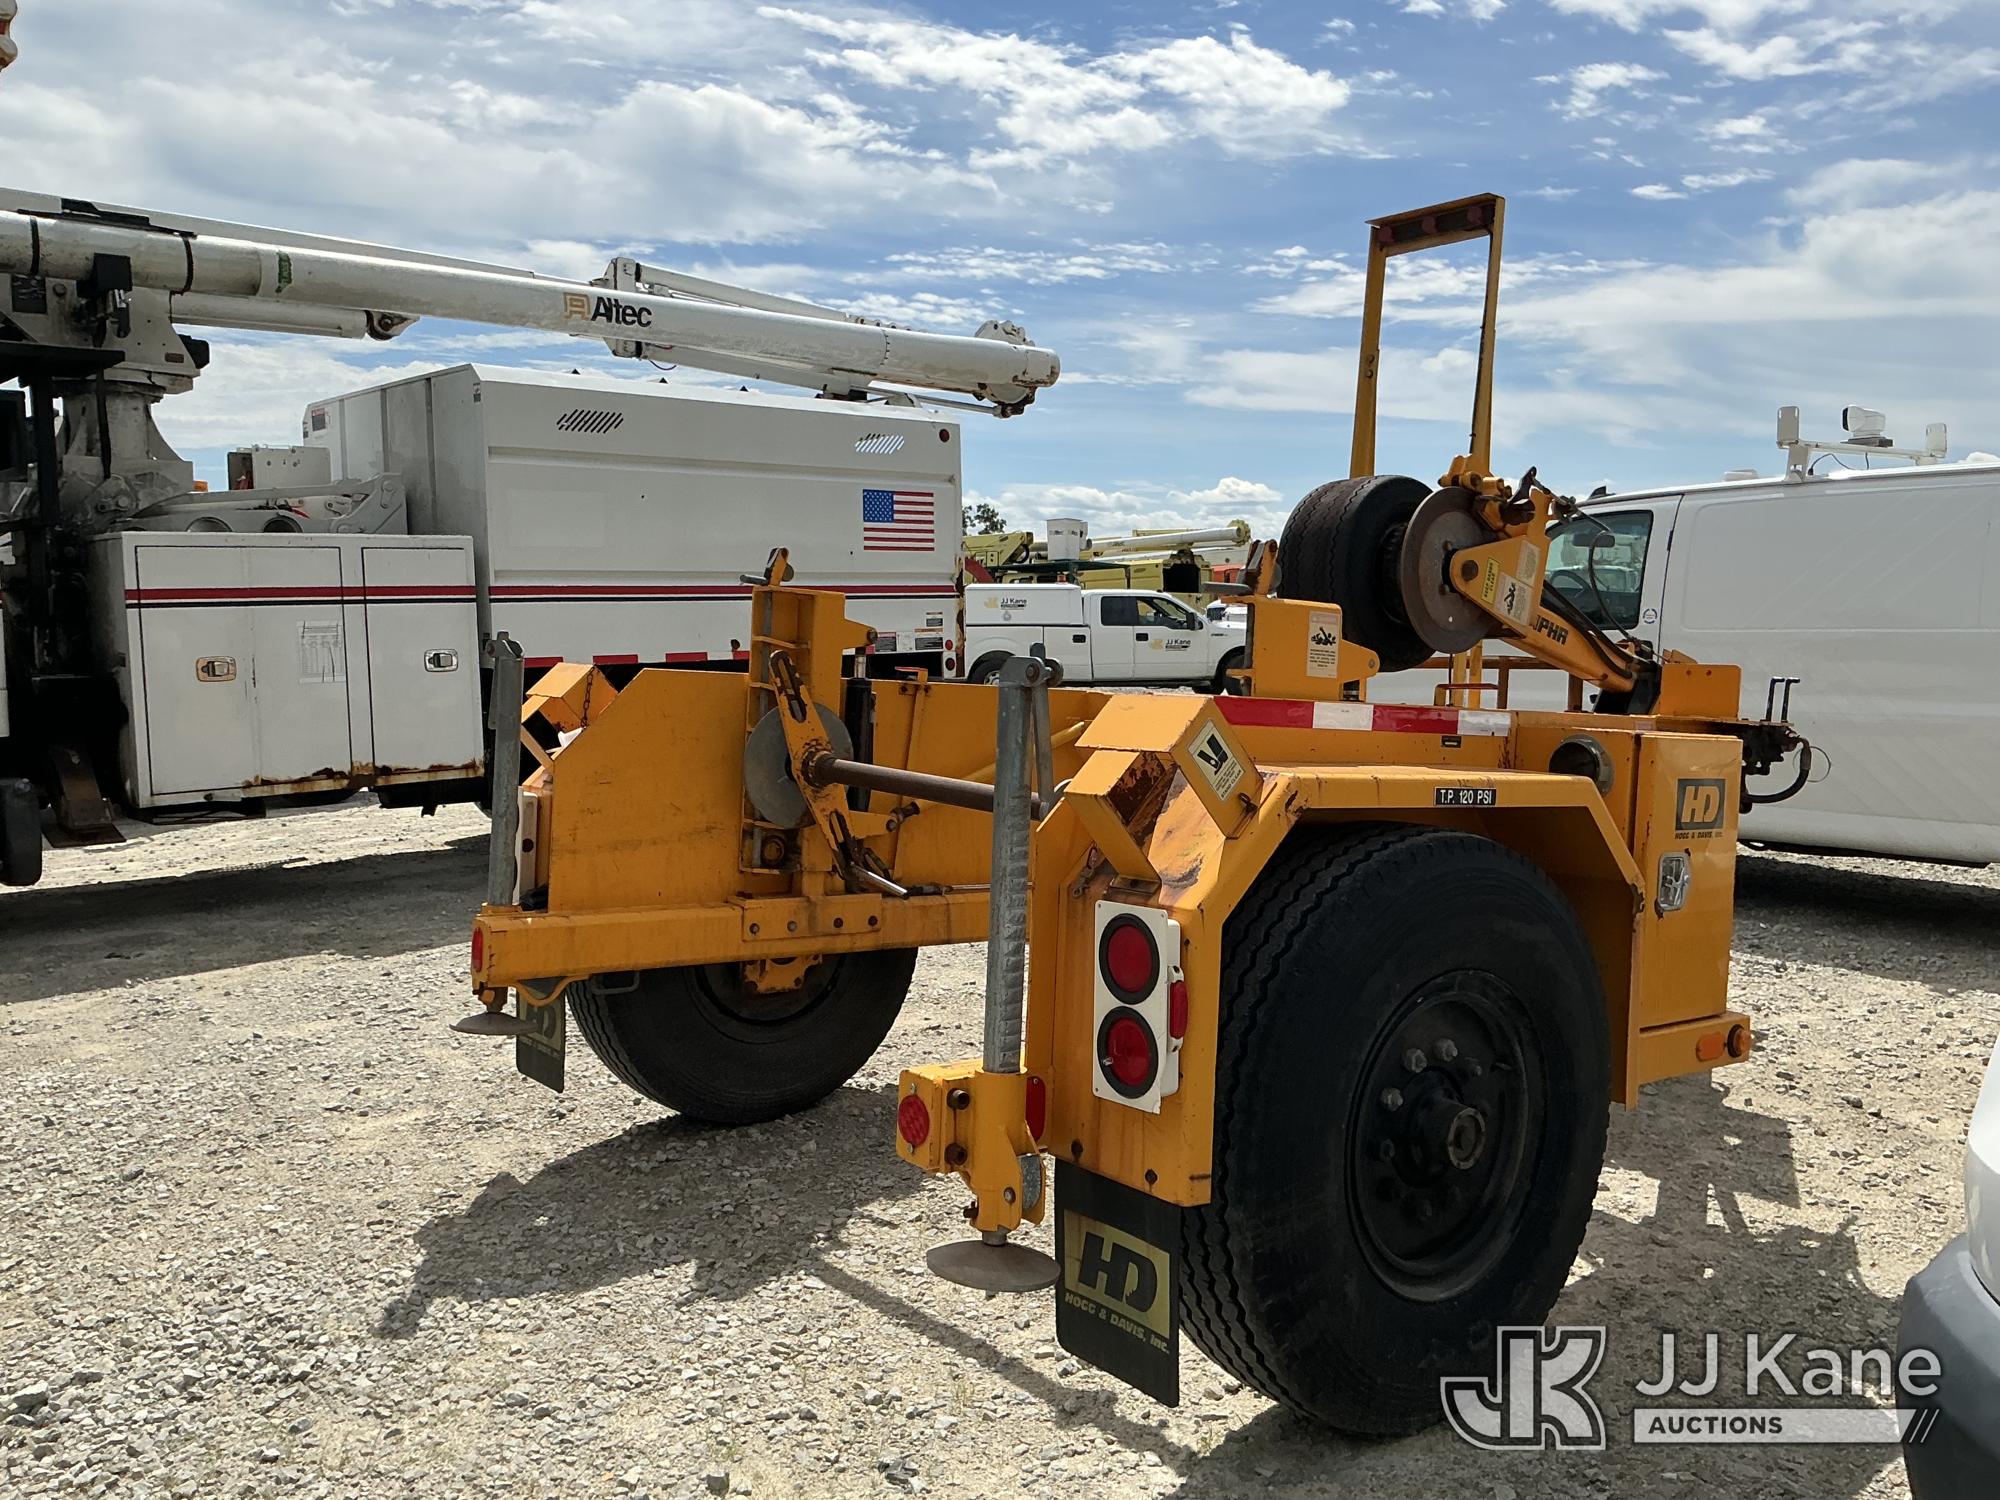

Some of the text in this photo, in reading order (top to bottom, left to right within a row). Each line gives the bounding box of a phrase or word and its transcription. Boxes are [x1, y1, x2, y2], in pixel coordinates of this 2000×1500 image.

[591, 296, 652, 328] Altec
[1440, 789, 1492, 804] T.P. 120 PSI
[1681, 785, 1720, 823] HD
[1078, 1231, 1158, 1313] HD
[1064, 1292, 1097, 1314] HOGG
[1098, 1307, 1108, 1321] &
[1110, 1315, 1147, 1342] DAVIS,
